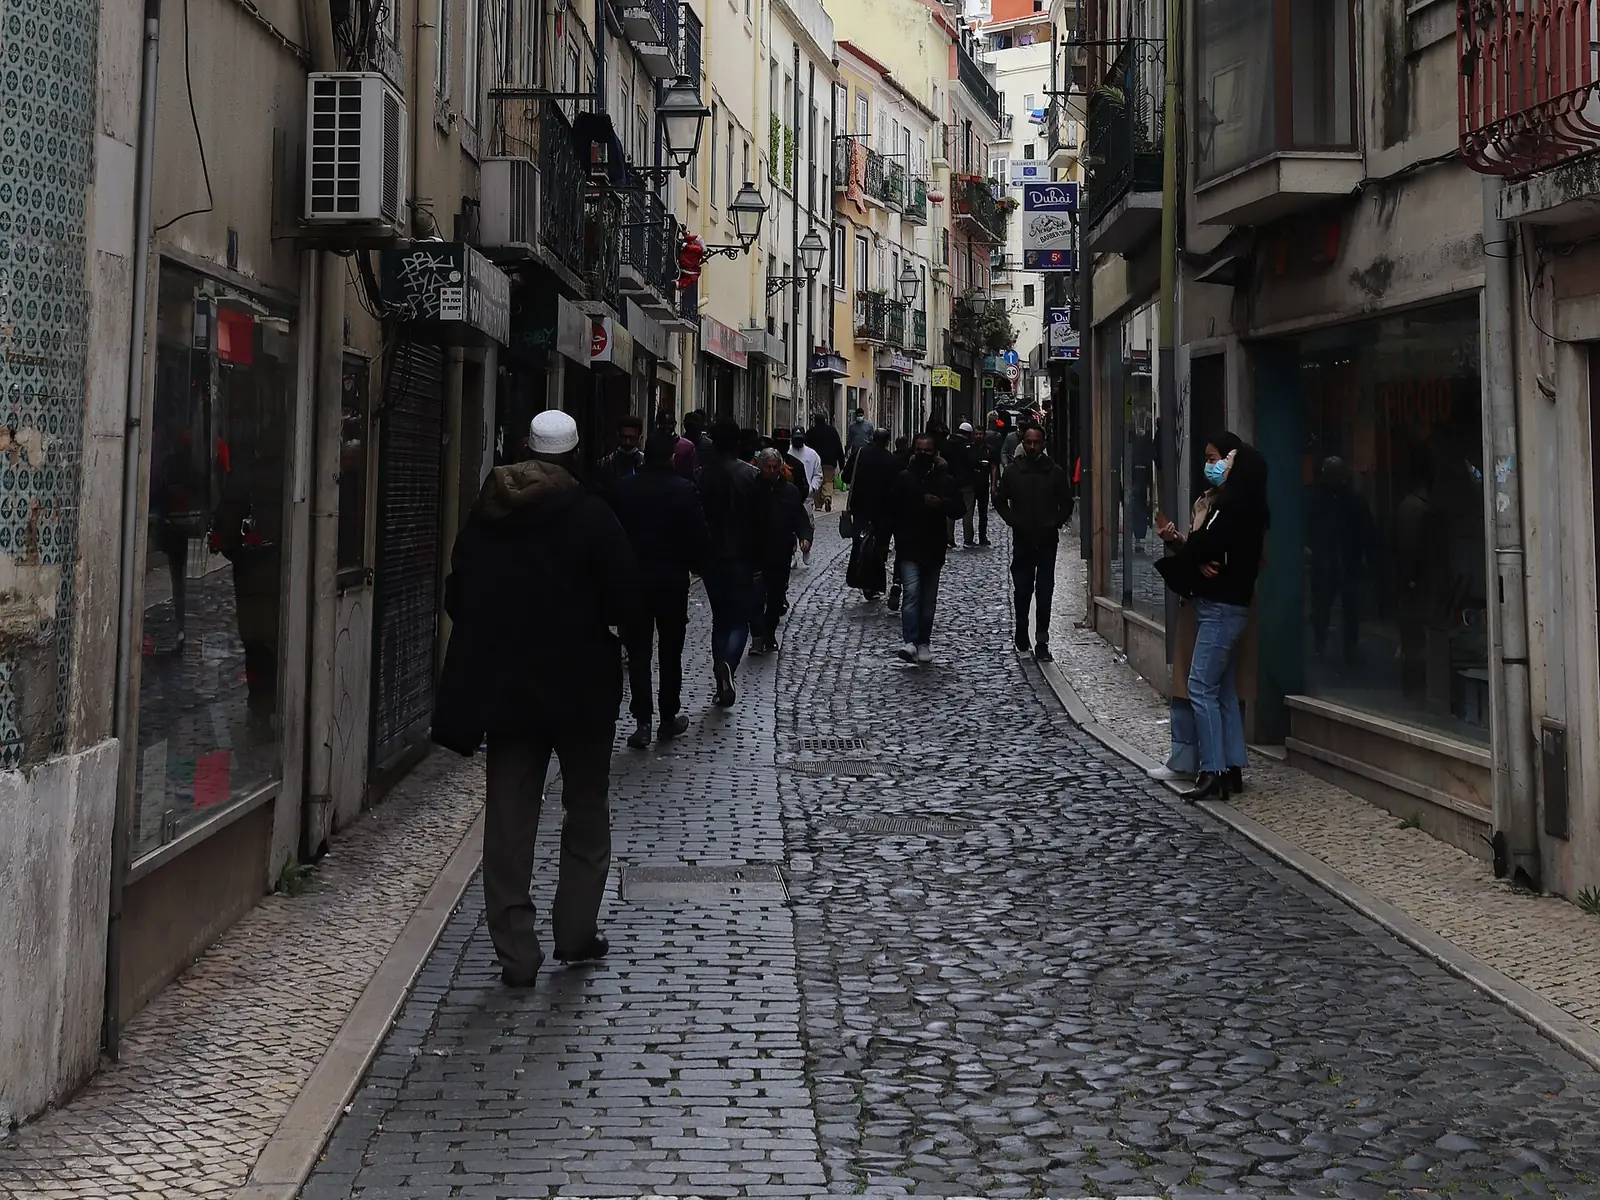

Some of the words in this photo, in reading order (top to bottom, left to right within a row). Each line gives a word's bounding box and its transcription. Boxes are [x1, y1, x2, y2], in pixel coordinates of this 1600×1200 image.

[1029, 187, 1073, 207] Dubai
[1039, 230, 1061, 243] BARBER
[816, 359, 825, 368] 45
